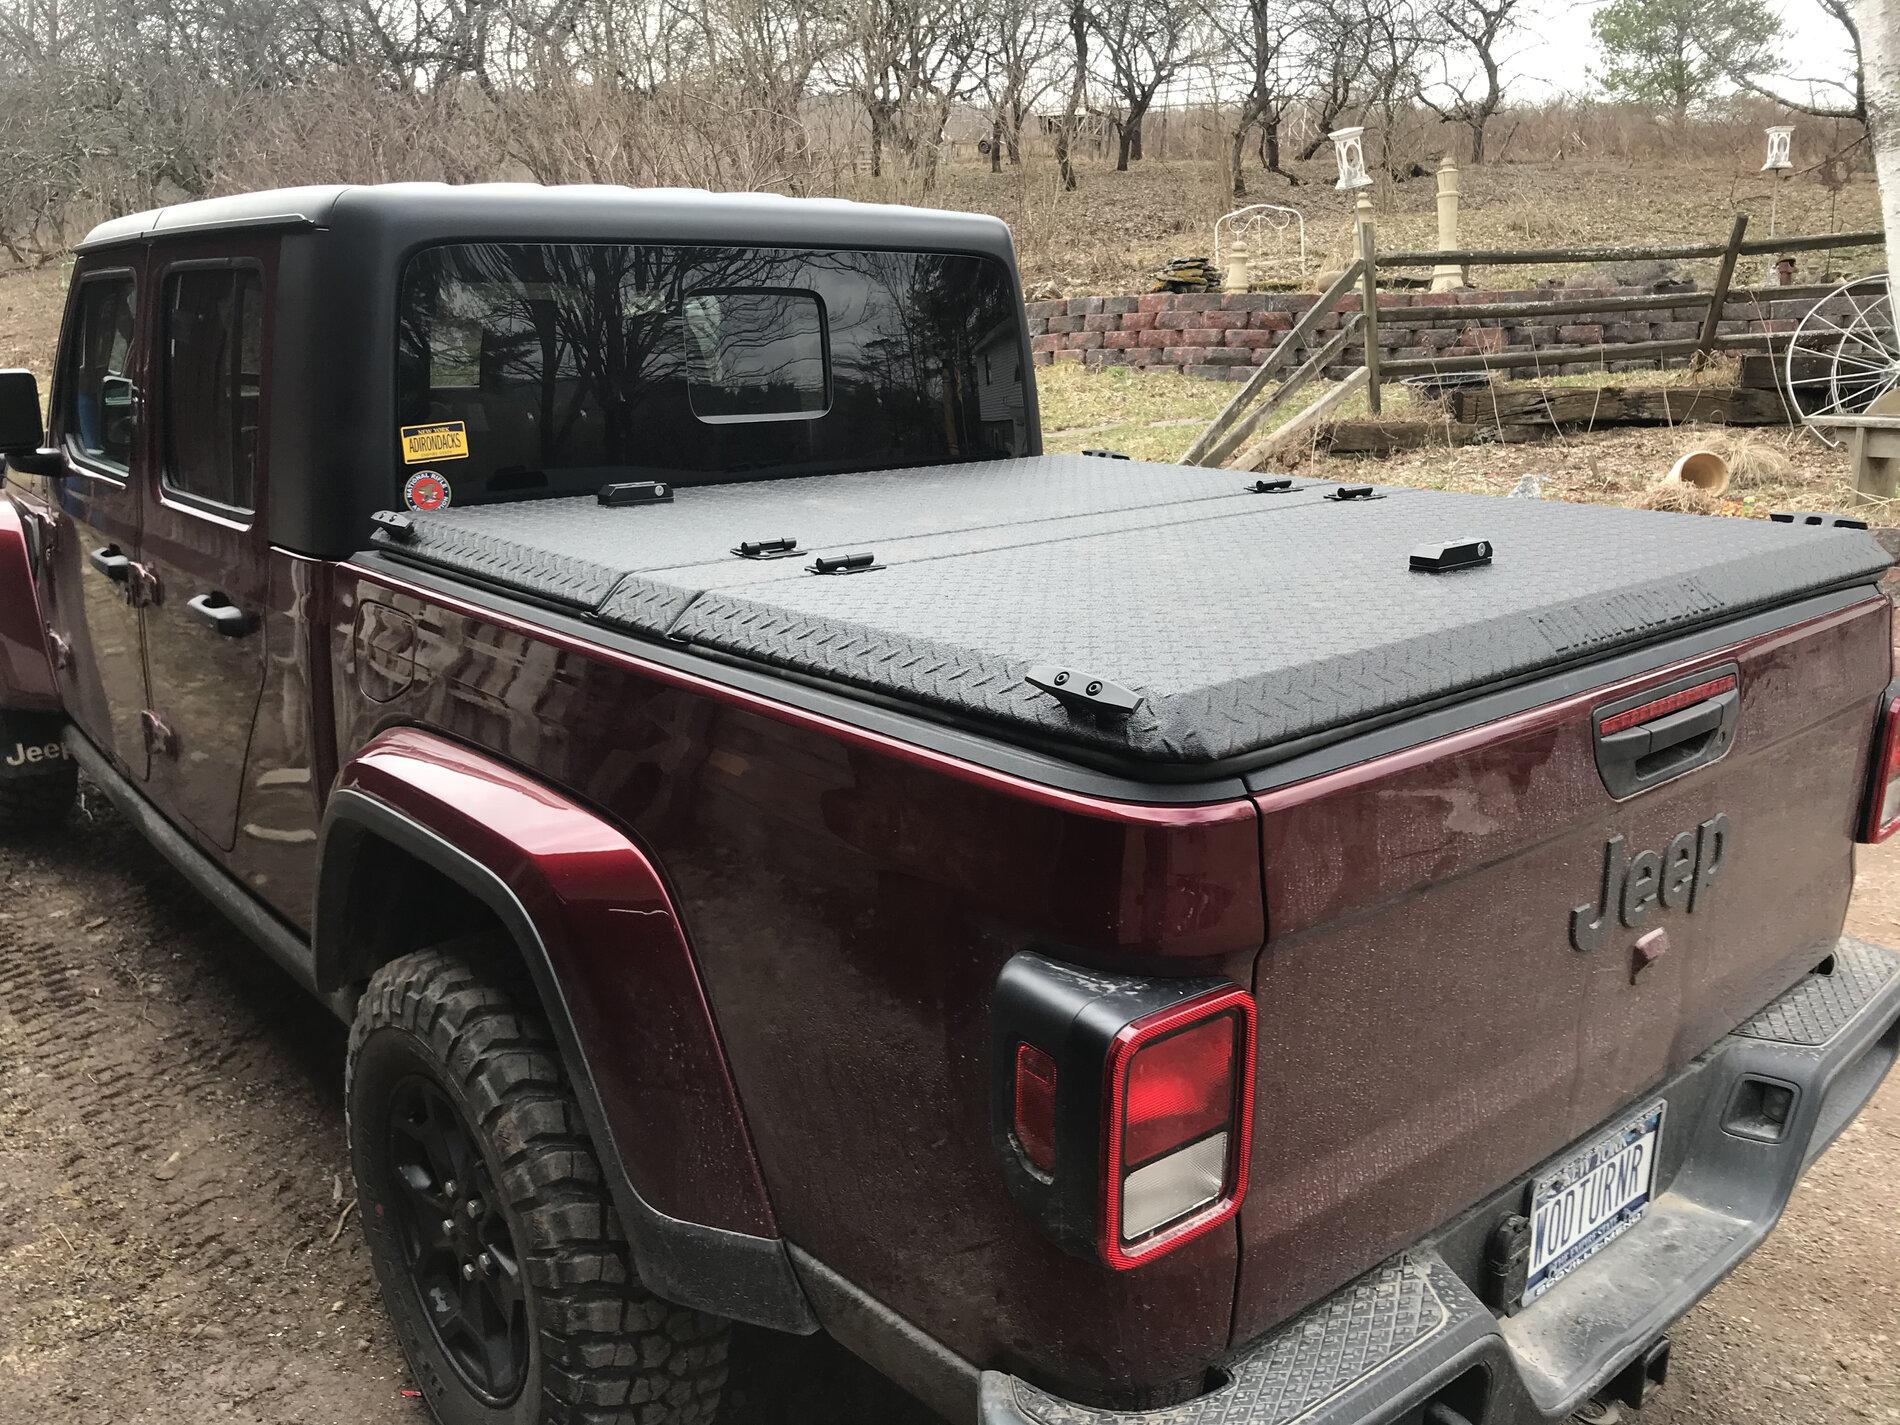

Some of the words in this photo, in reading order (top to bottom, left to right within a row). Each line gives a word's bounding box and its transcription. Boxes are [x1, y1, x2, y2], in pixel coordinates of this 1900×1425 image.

[409, 433, 462, 453] ADIRONDACKS
[407, 473, 430, 498] NATIONAL
[430, 473, 448, 489] RIFLE
[1569, 812, 1730, 951] Jeep
[1534, 1144, 1643, 1268] WODTURNR
